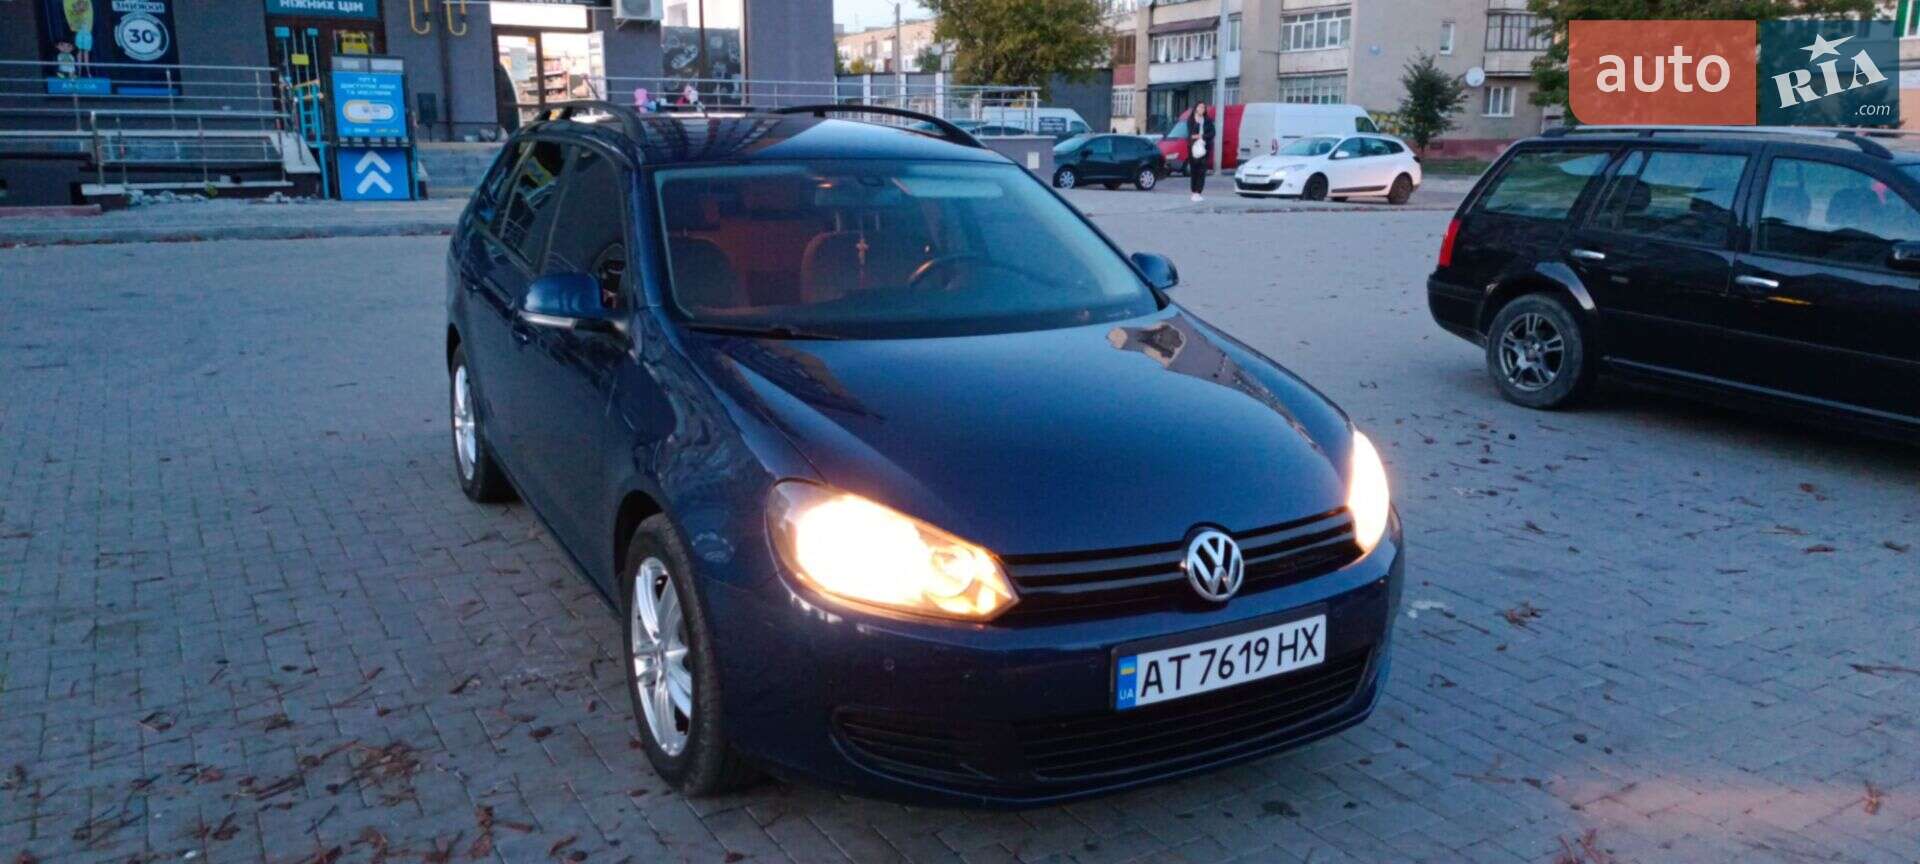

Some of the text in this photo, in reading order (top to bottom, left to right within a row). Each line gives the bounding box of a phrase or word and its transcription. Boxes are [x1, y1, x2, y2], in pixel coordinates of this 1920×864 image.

[1140, 622, 1320, 698] AT 7619 HX
[1119, 689, 1134, 700] UA
